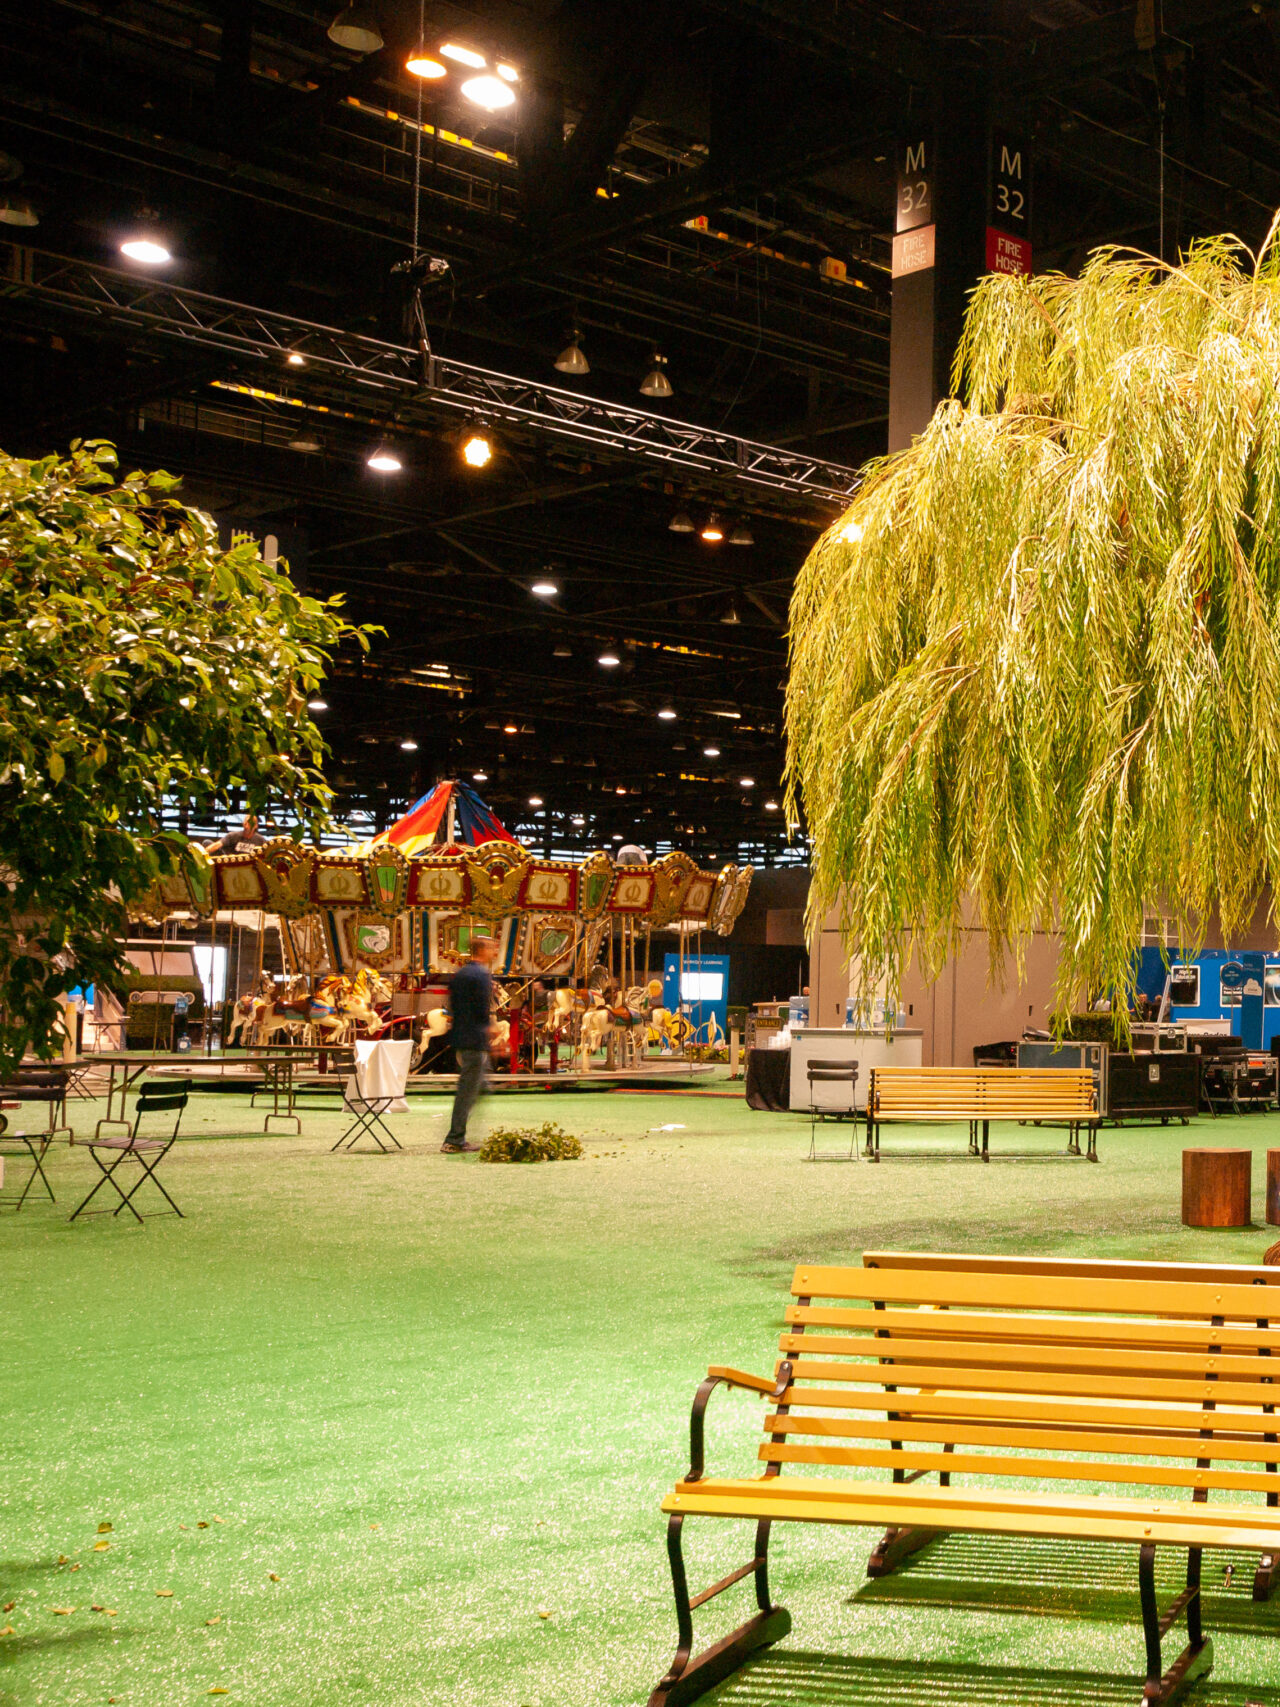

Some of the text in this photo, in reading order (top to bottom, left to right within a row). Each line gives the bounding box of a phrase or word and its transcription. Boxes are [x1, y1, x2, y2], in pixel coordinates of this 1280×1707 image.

[905, 141, 925, 174] M
[1001, 145, 1022, 180] M
[901, 181, 928, 214] 32
[997, 184, 1024, 220] 32
[903, 234, 925, 252] FIRE
[998, 237, 1022, 259] FIRE
[901, 251, 927, 270] HOSE
[995, 253, 1024, 275] HOSE
